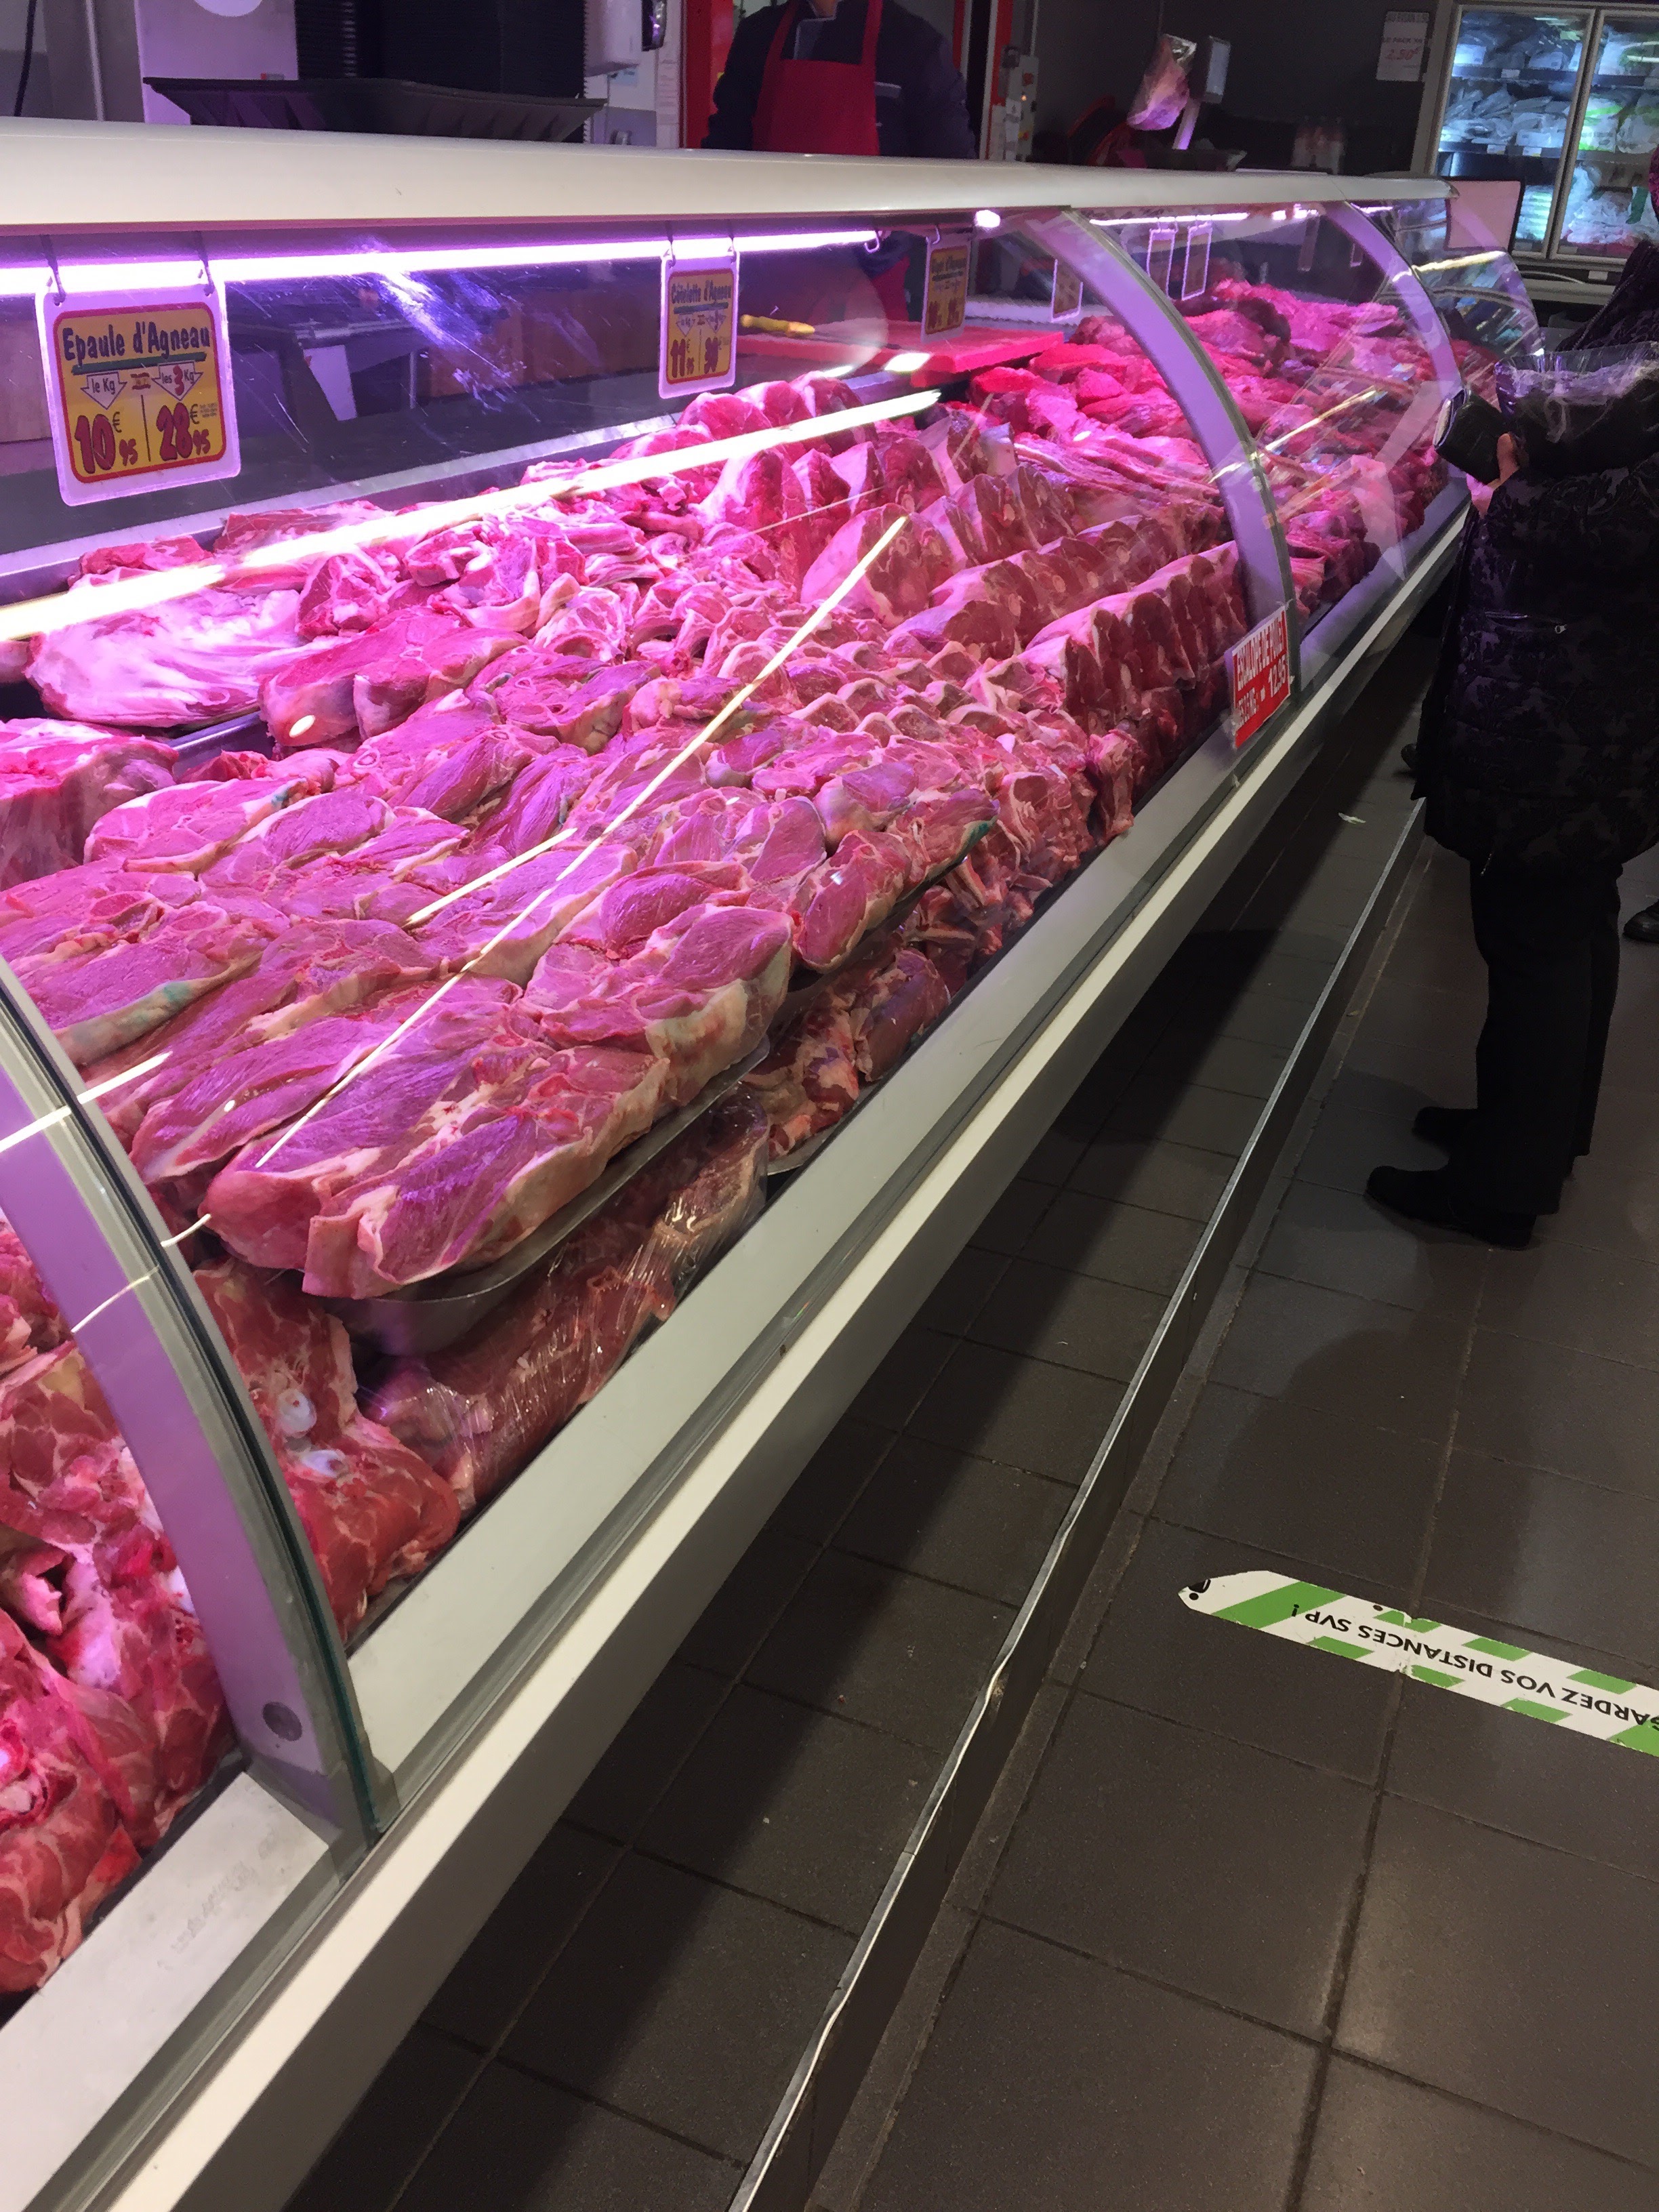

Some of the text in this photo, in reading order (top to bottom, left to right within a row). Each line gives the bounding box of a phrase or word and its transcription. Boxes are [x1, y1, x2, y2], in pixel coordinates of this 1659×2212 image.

[62, 321, 211, 367] Epaule d'Agneau
[91, 377, 116, 395] le Kg
[161, 365, 196, 396] les 3 Kg
[1305, 1610, 1352, 1633] SVP
[1357, 1624, 1494, 1678] DISTANCES
[1500, 1669, 1556, 1699] VOS
